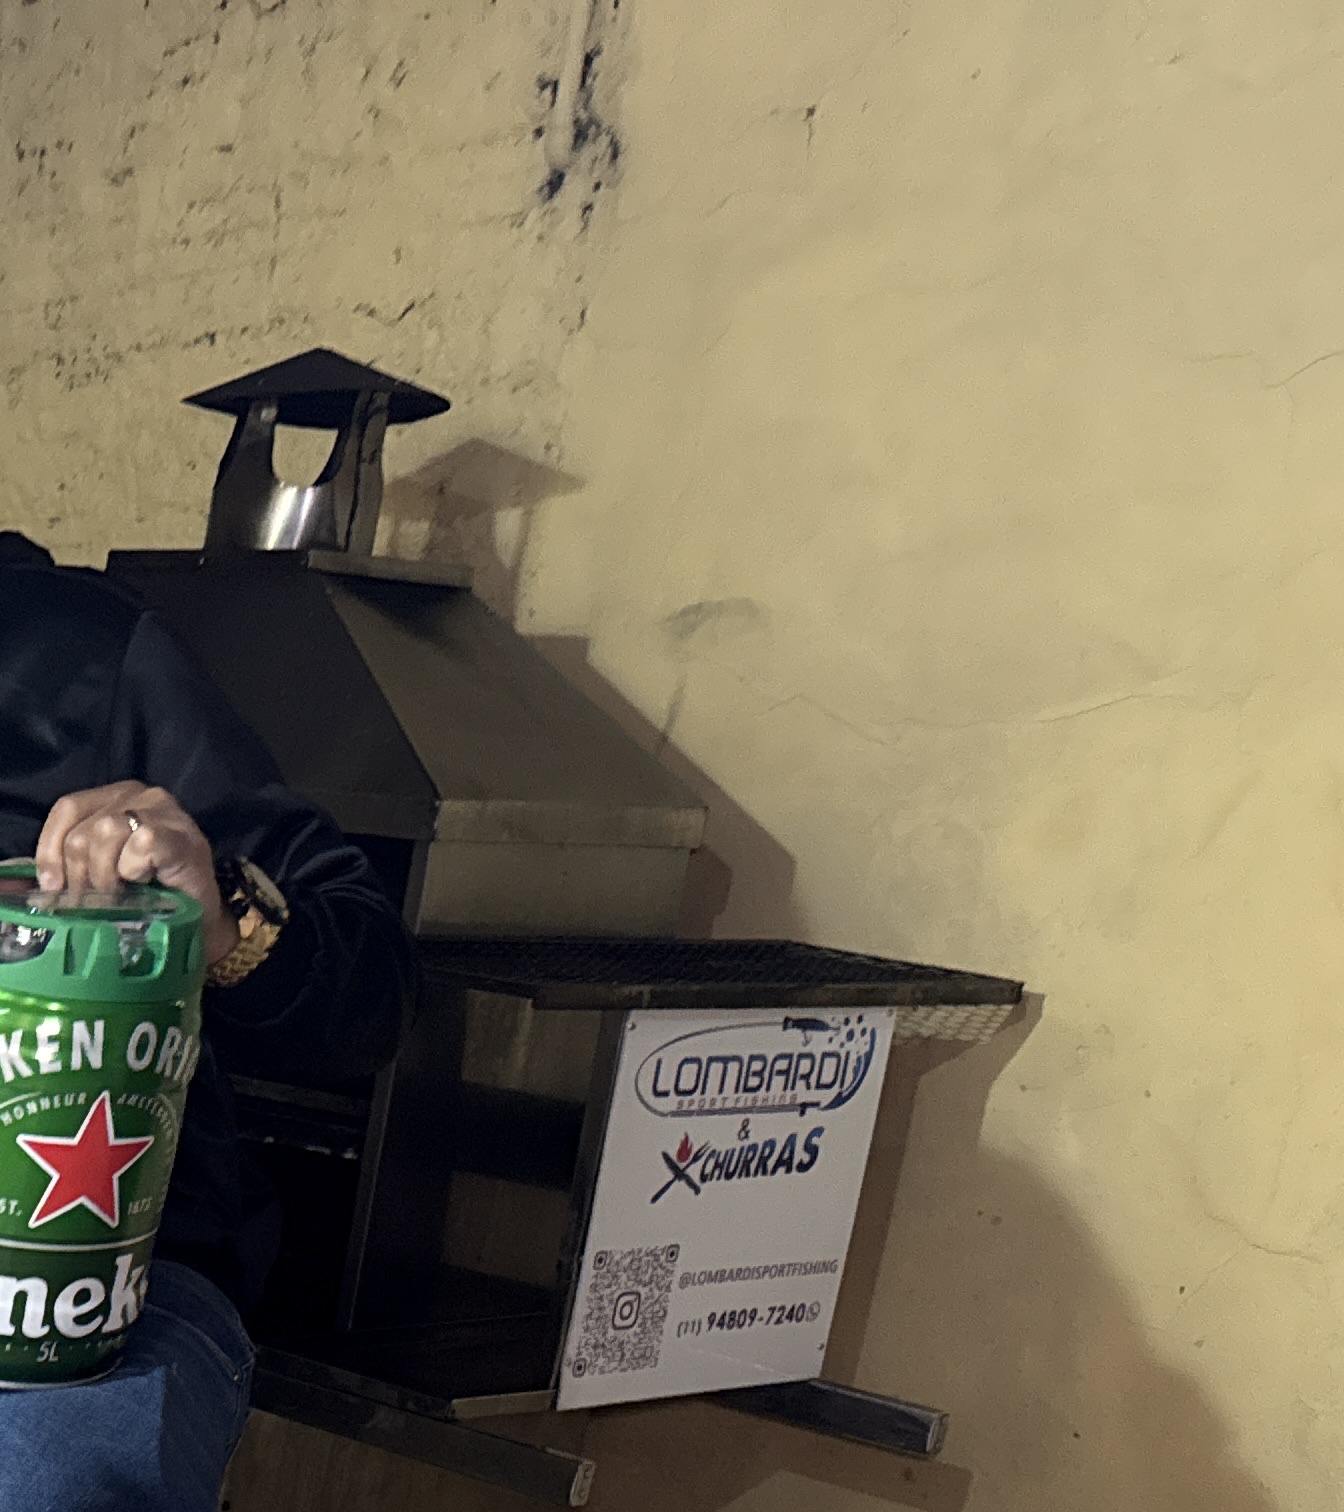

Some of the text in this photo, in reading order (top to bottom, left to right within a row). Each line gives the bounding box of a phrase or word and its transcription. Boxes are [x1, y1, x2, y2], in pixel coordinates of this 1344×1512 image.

[651, 1050, 851, 1098] LOMBARDI
[737, 1117, 751, 1142] &
[699, 1125, 826, 1184] CHURRAS
[706, 1302, 807, 1333] 94809-7240
